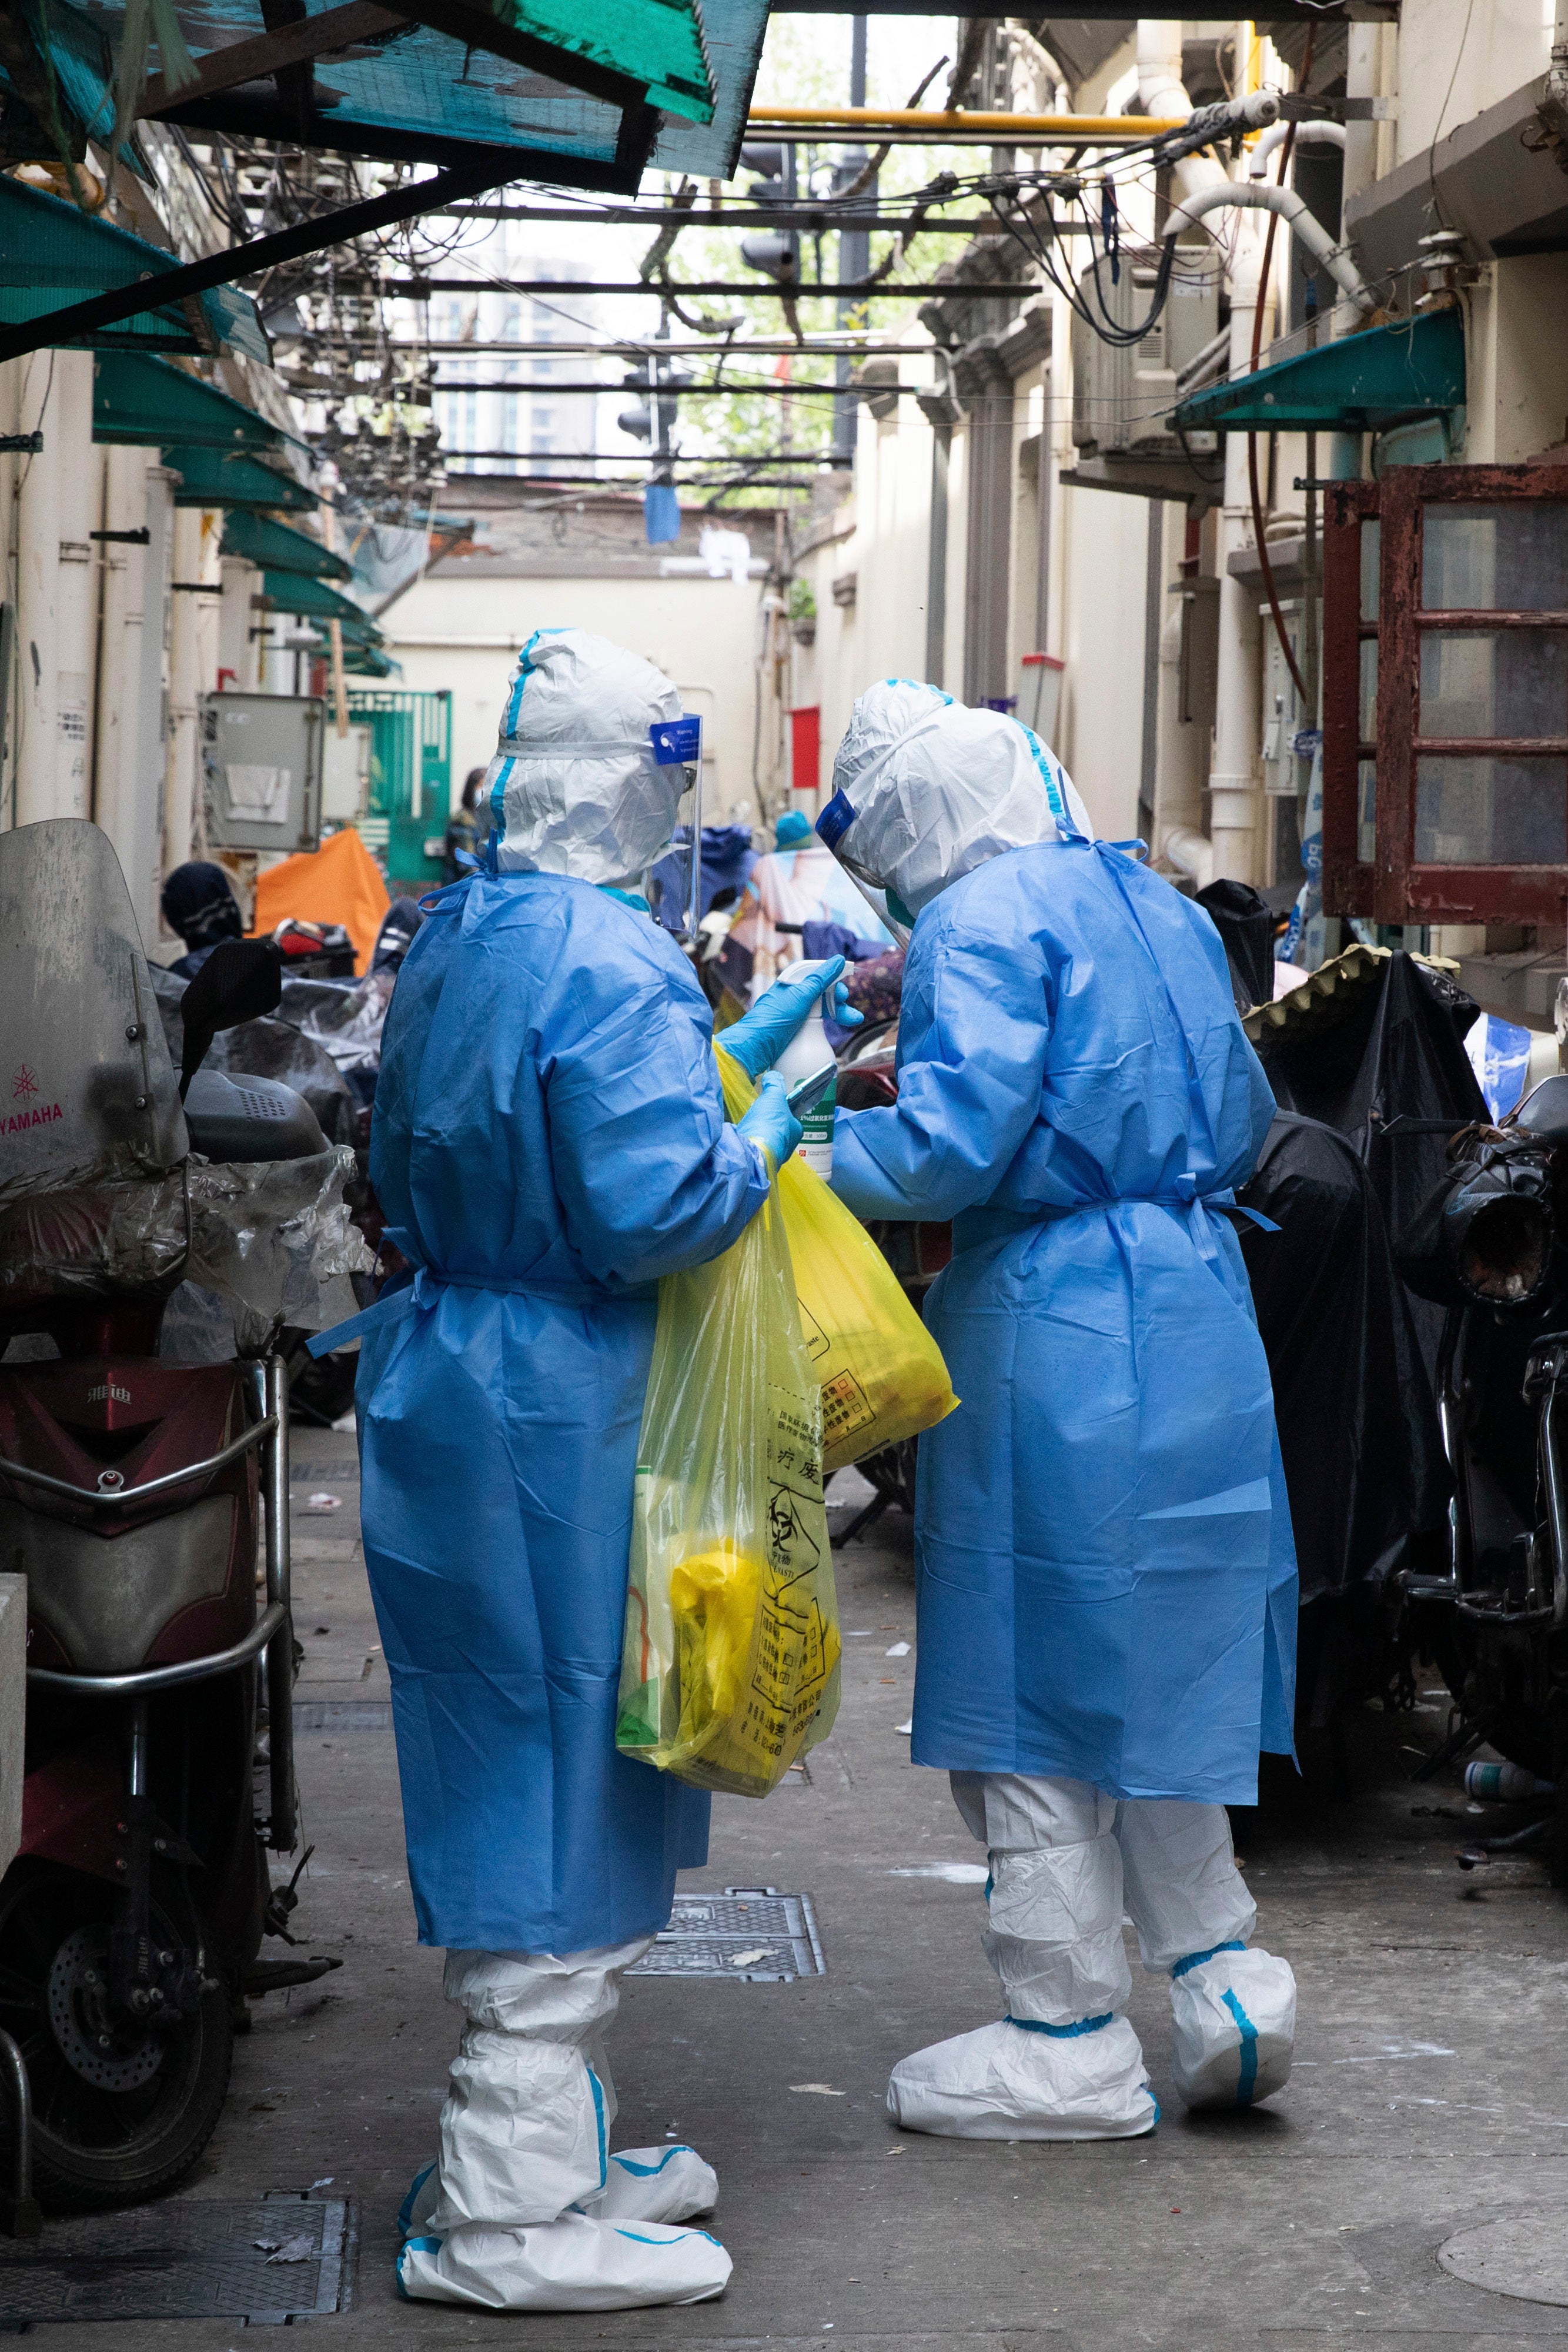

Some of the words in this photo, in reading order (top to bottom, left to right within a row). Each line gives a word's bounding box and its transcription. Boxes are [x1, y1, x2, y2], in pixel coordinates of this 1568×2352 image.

[0, 1103, 63, 1135] YAMAHA
[807, 1335, 820, 1347] aste
[87, 1384, 132, 1404] 雅迪
[821, 1385, 837, 1402] 废物
